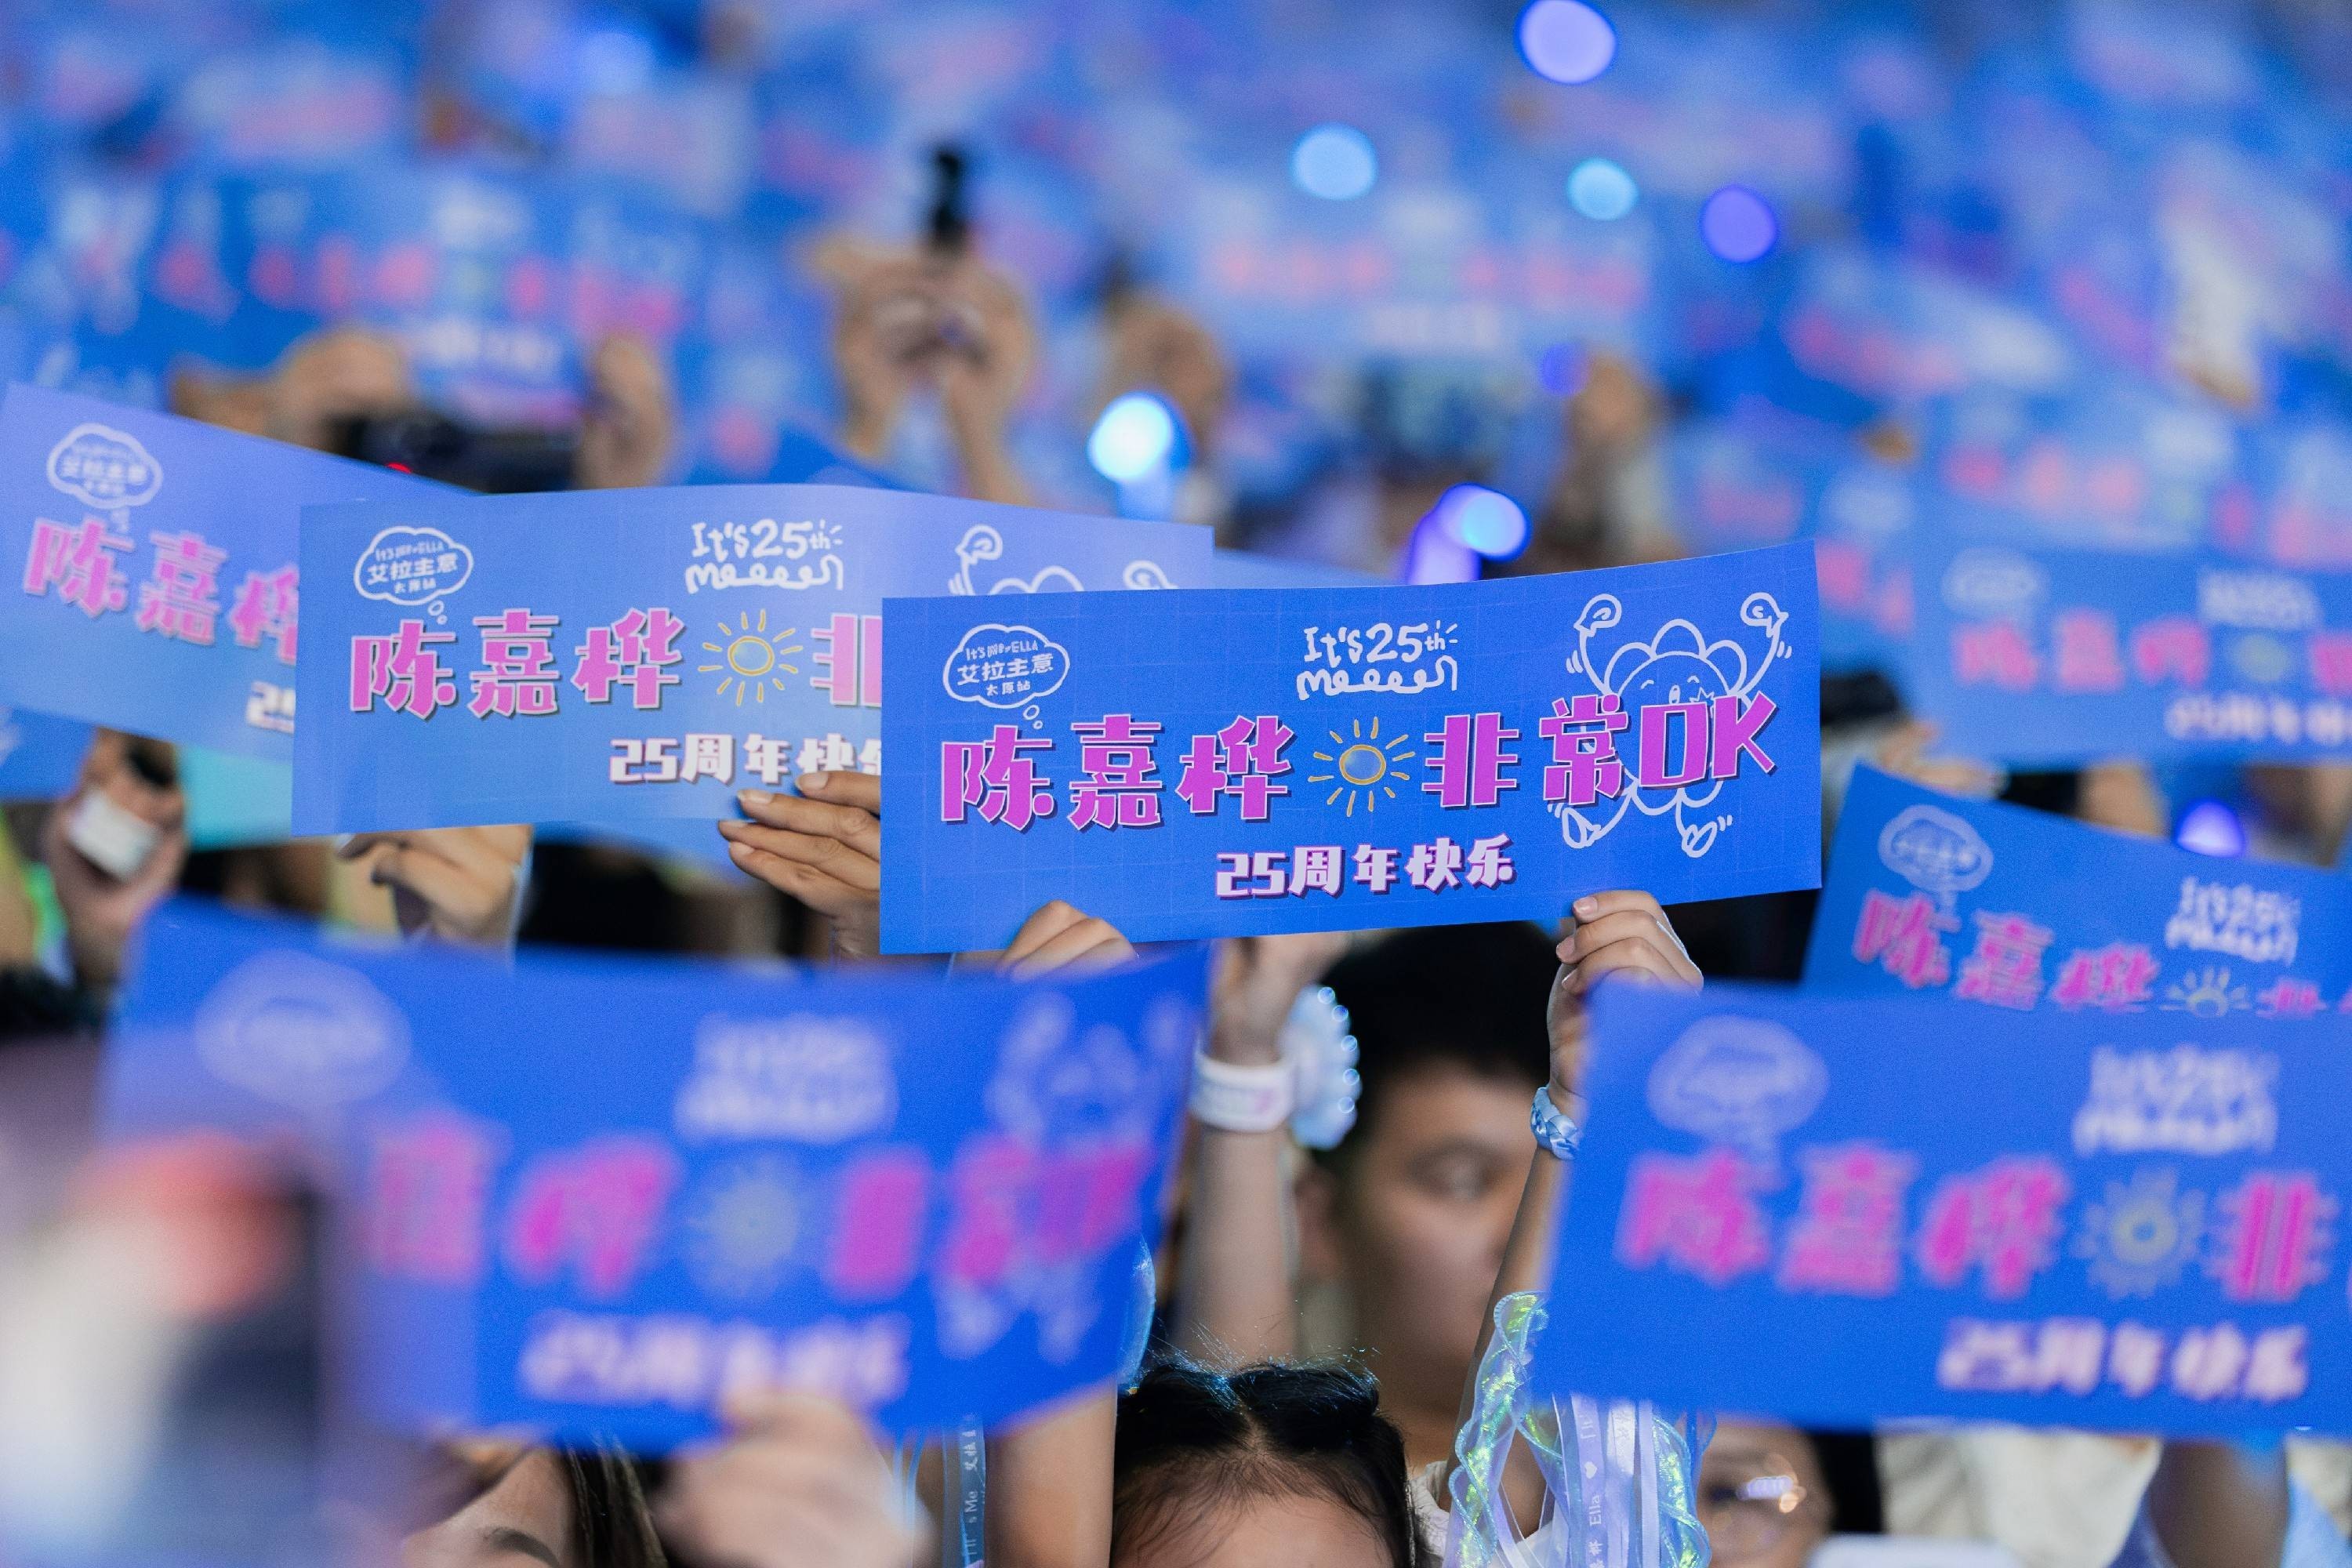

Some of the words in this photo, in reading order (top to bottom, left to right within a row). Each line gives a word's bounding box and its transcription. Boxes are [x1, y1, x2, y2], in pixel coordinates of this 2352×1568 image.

[350, 608, 685, 719] 陈嘉桦
[957, 653, 1053, 685] 艾拉主意
[1304, 626, 1363, 668] It's
[941, 714, 1294, 831] 陈嘉桦
[1421, 691, 1780, 809] 非常OK
[1215, 833, 1515, 898] 25周年快乐
[1588, 1494, 1602, 1526] Ella
